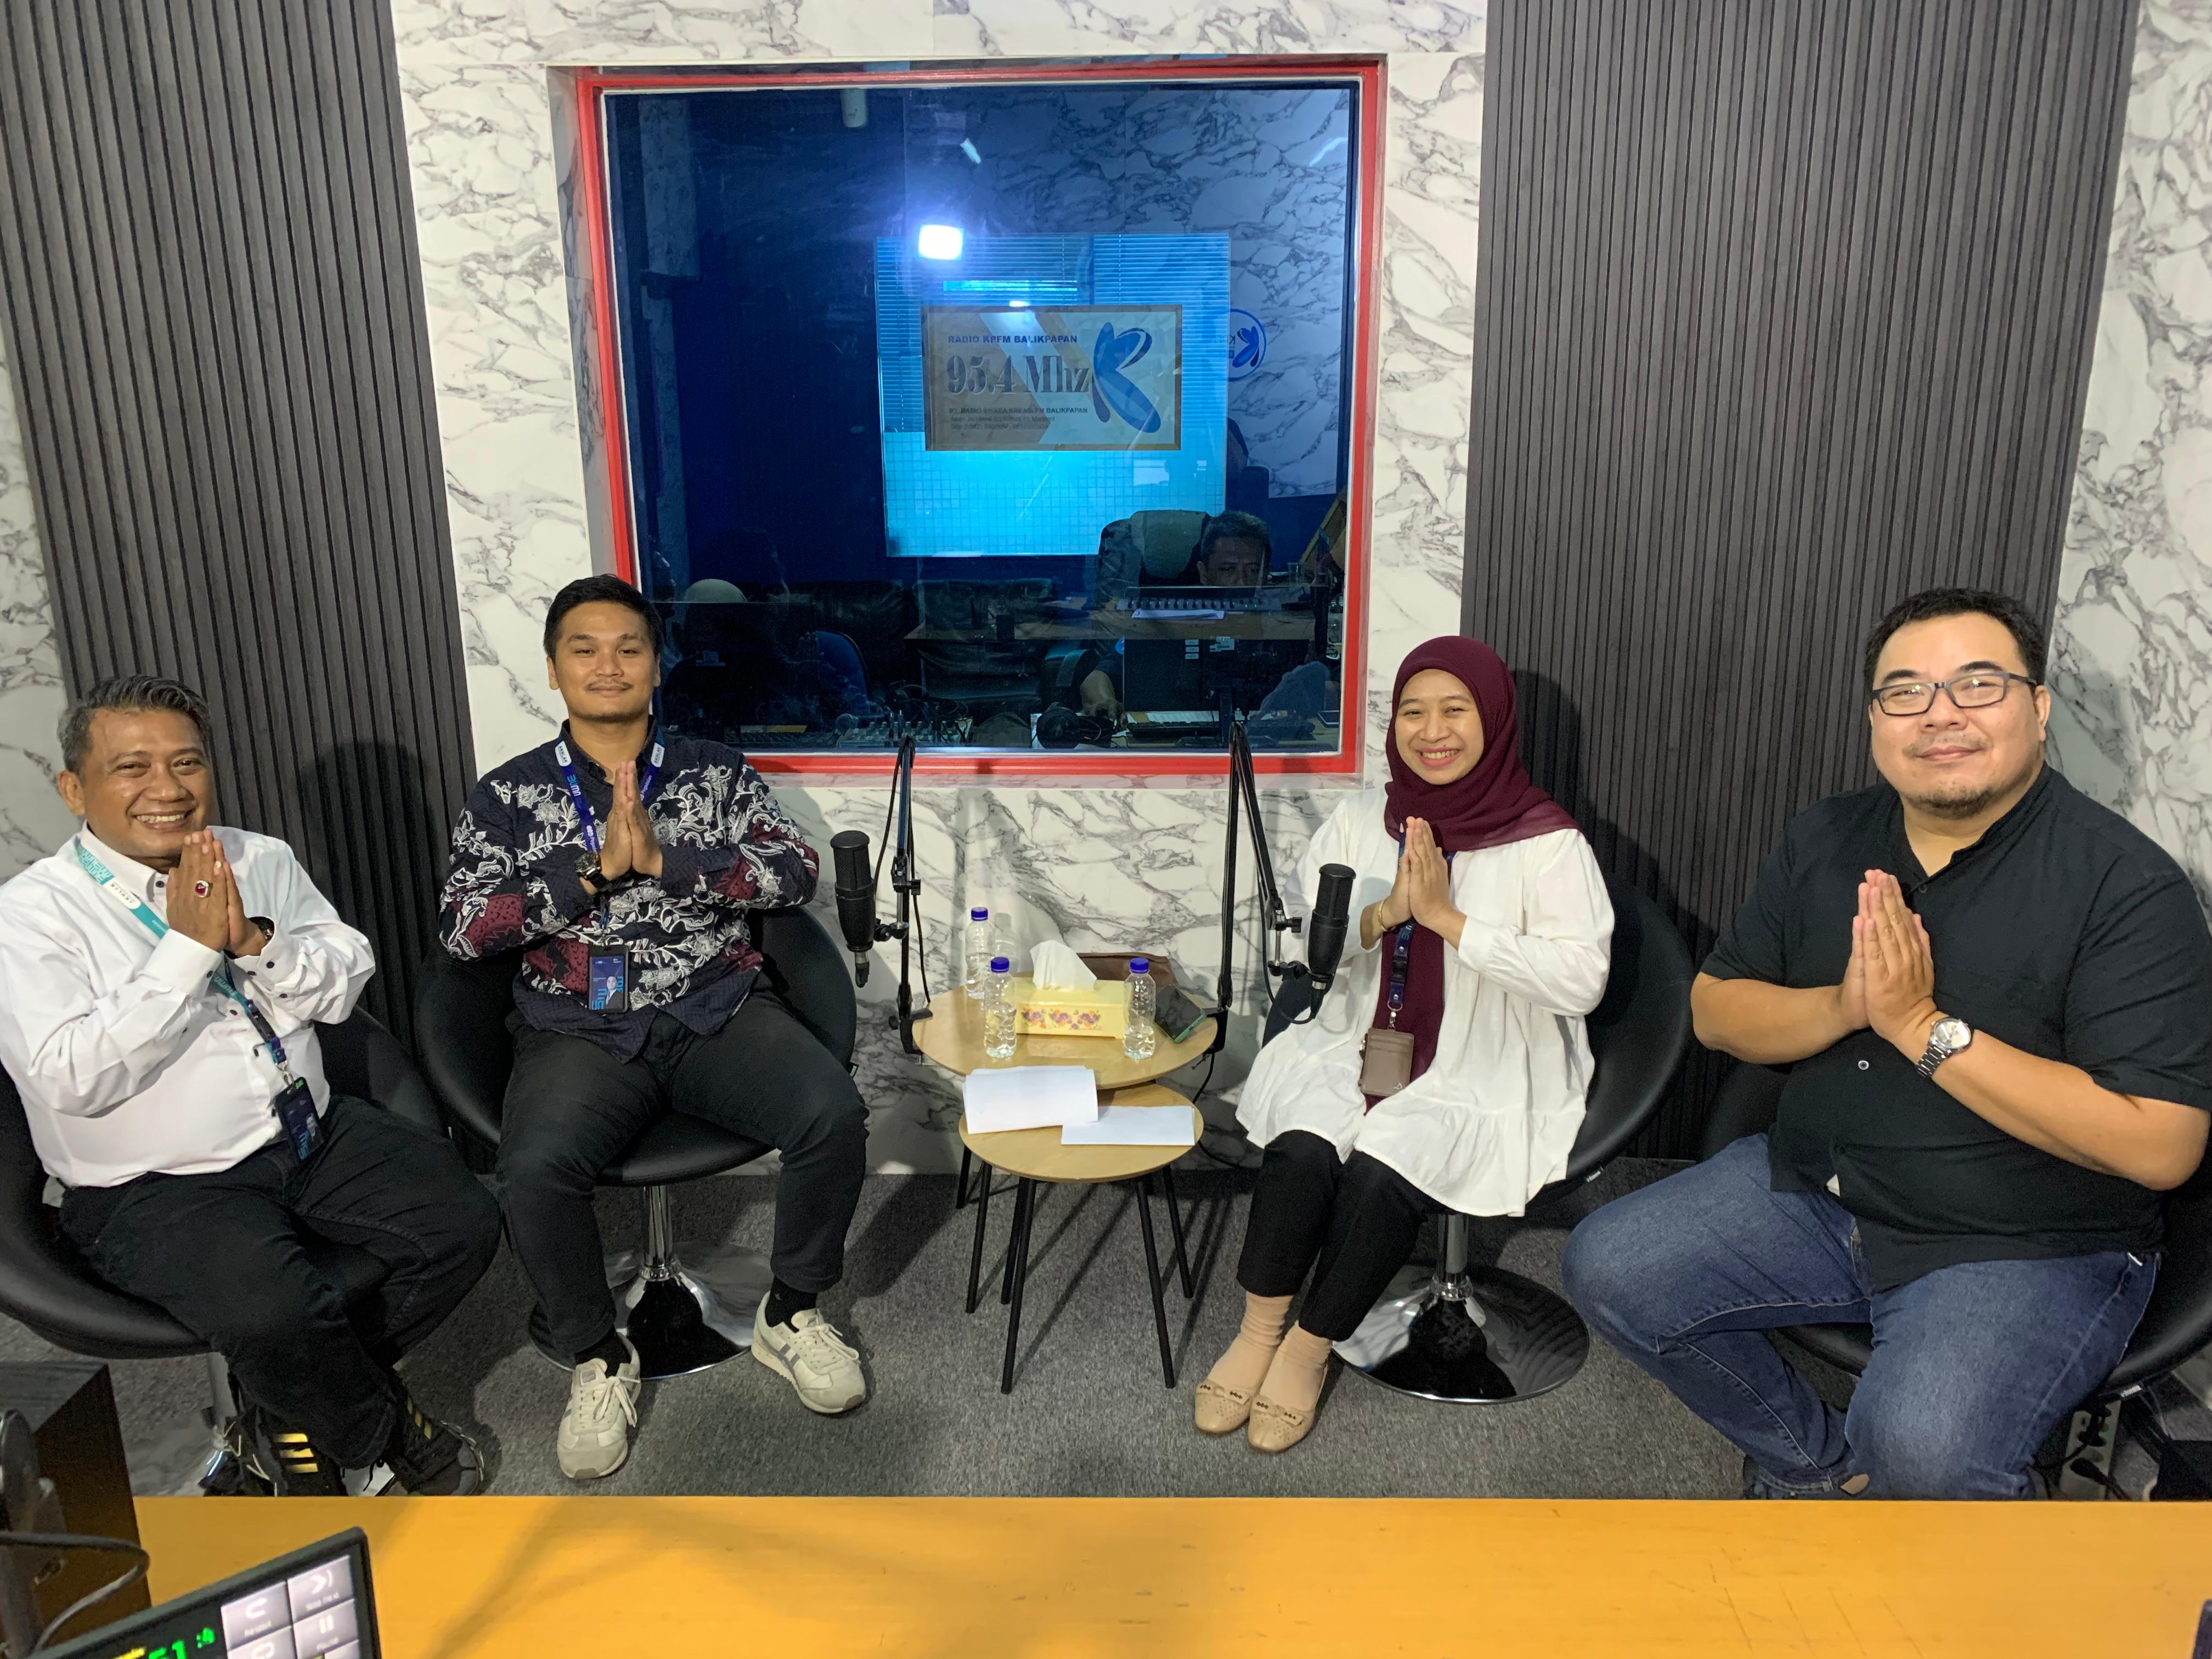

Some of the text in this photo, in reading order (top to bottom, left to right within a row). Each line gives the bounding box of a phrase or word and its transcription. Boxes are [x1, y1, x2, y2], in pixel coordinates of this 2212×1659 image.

[947, 335, 979, 343] RADIO
[1014, 335, 1077, 343] BALIKPAPAN
[947, 355, 1090, 395] 95.4 Mhz
[559, 746, 567, 763] AKHLAK
[110, 882, 136, 904] AKHLAK
